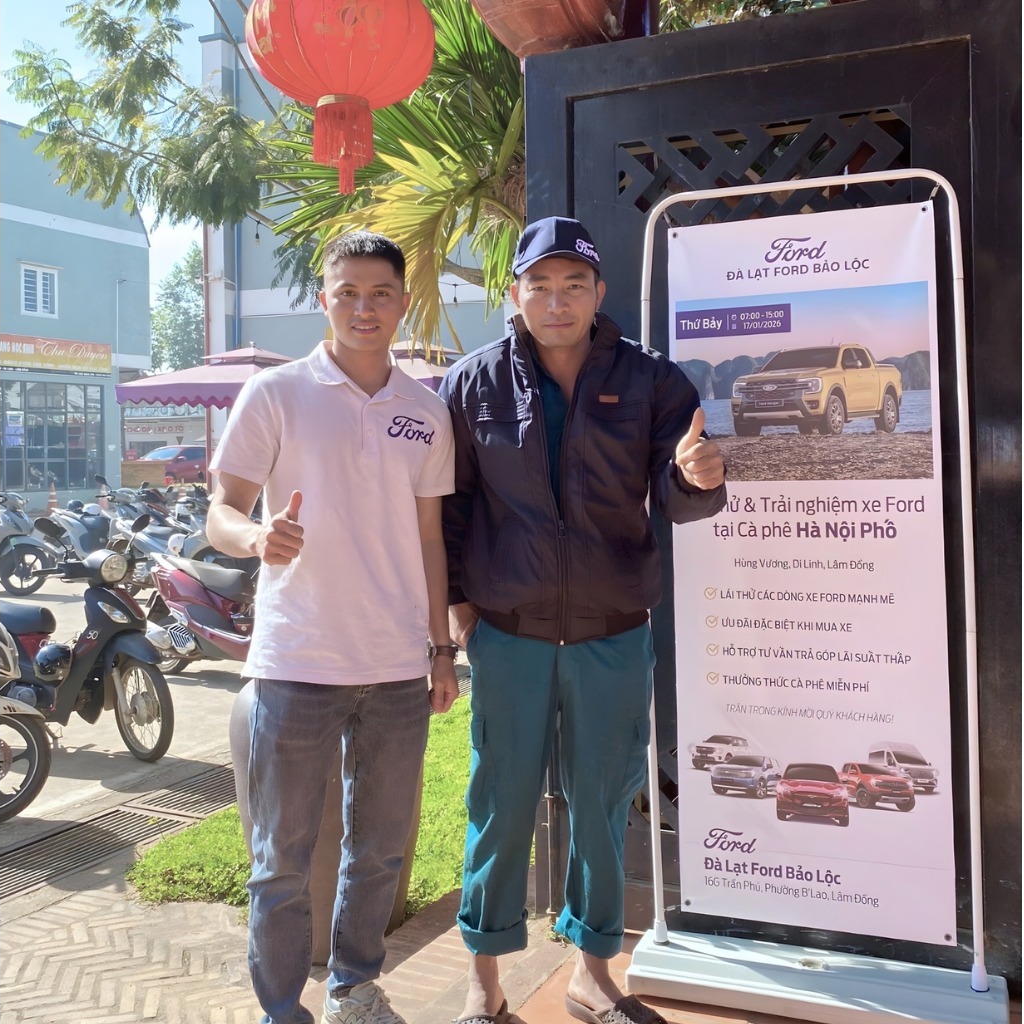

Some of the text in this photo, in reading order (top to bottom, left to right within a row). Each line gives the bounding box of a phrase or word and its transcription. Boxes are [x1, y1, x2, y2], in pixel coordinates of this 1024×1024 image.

[765, 237, 827, 263] Ford
[727, 258, 869, 280] ĐÀ LẠT FORD BẢO LỘC
[680, 317, 722, 331] Thứ Bảy
[740, 311, 760, 320] 07:00
[766, 310, 784, 318] 15:00
[743, 320, 781, 329] 17/01/2026
[387, 416, 434, 446] Ford
[744, 495, 924, 515] & Trải nghiệm xe Ford
[713, 519, 897, 542] tại Cà phê Hà Nội Phố
[704, 828, 756, 854] Ford
[704, 857, 841, 886] Đà Lạt Ford Bảo Lộc
